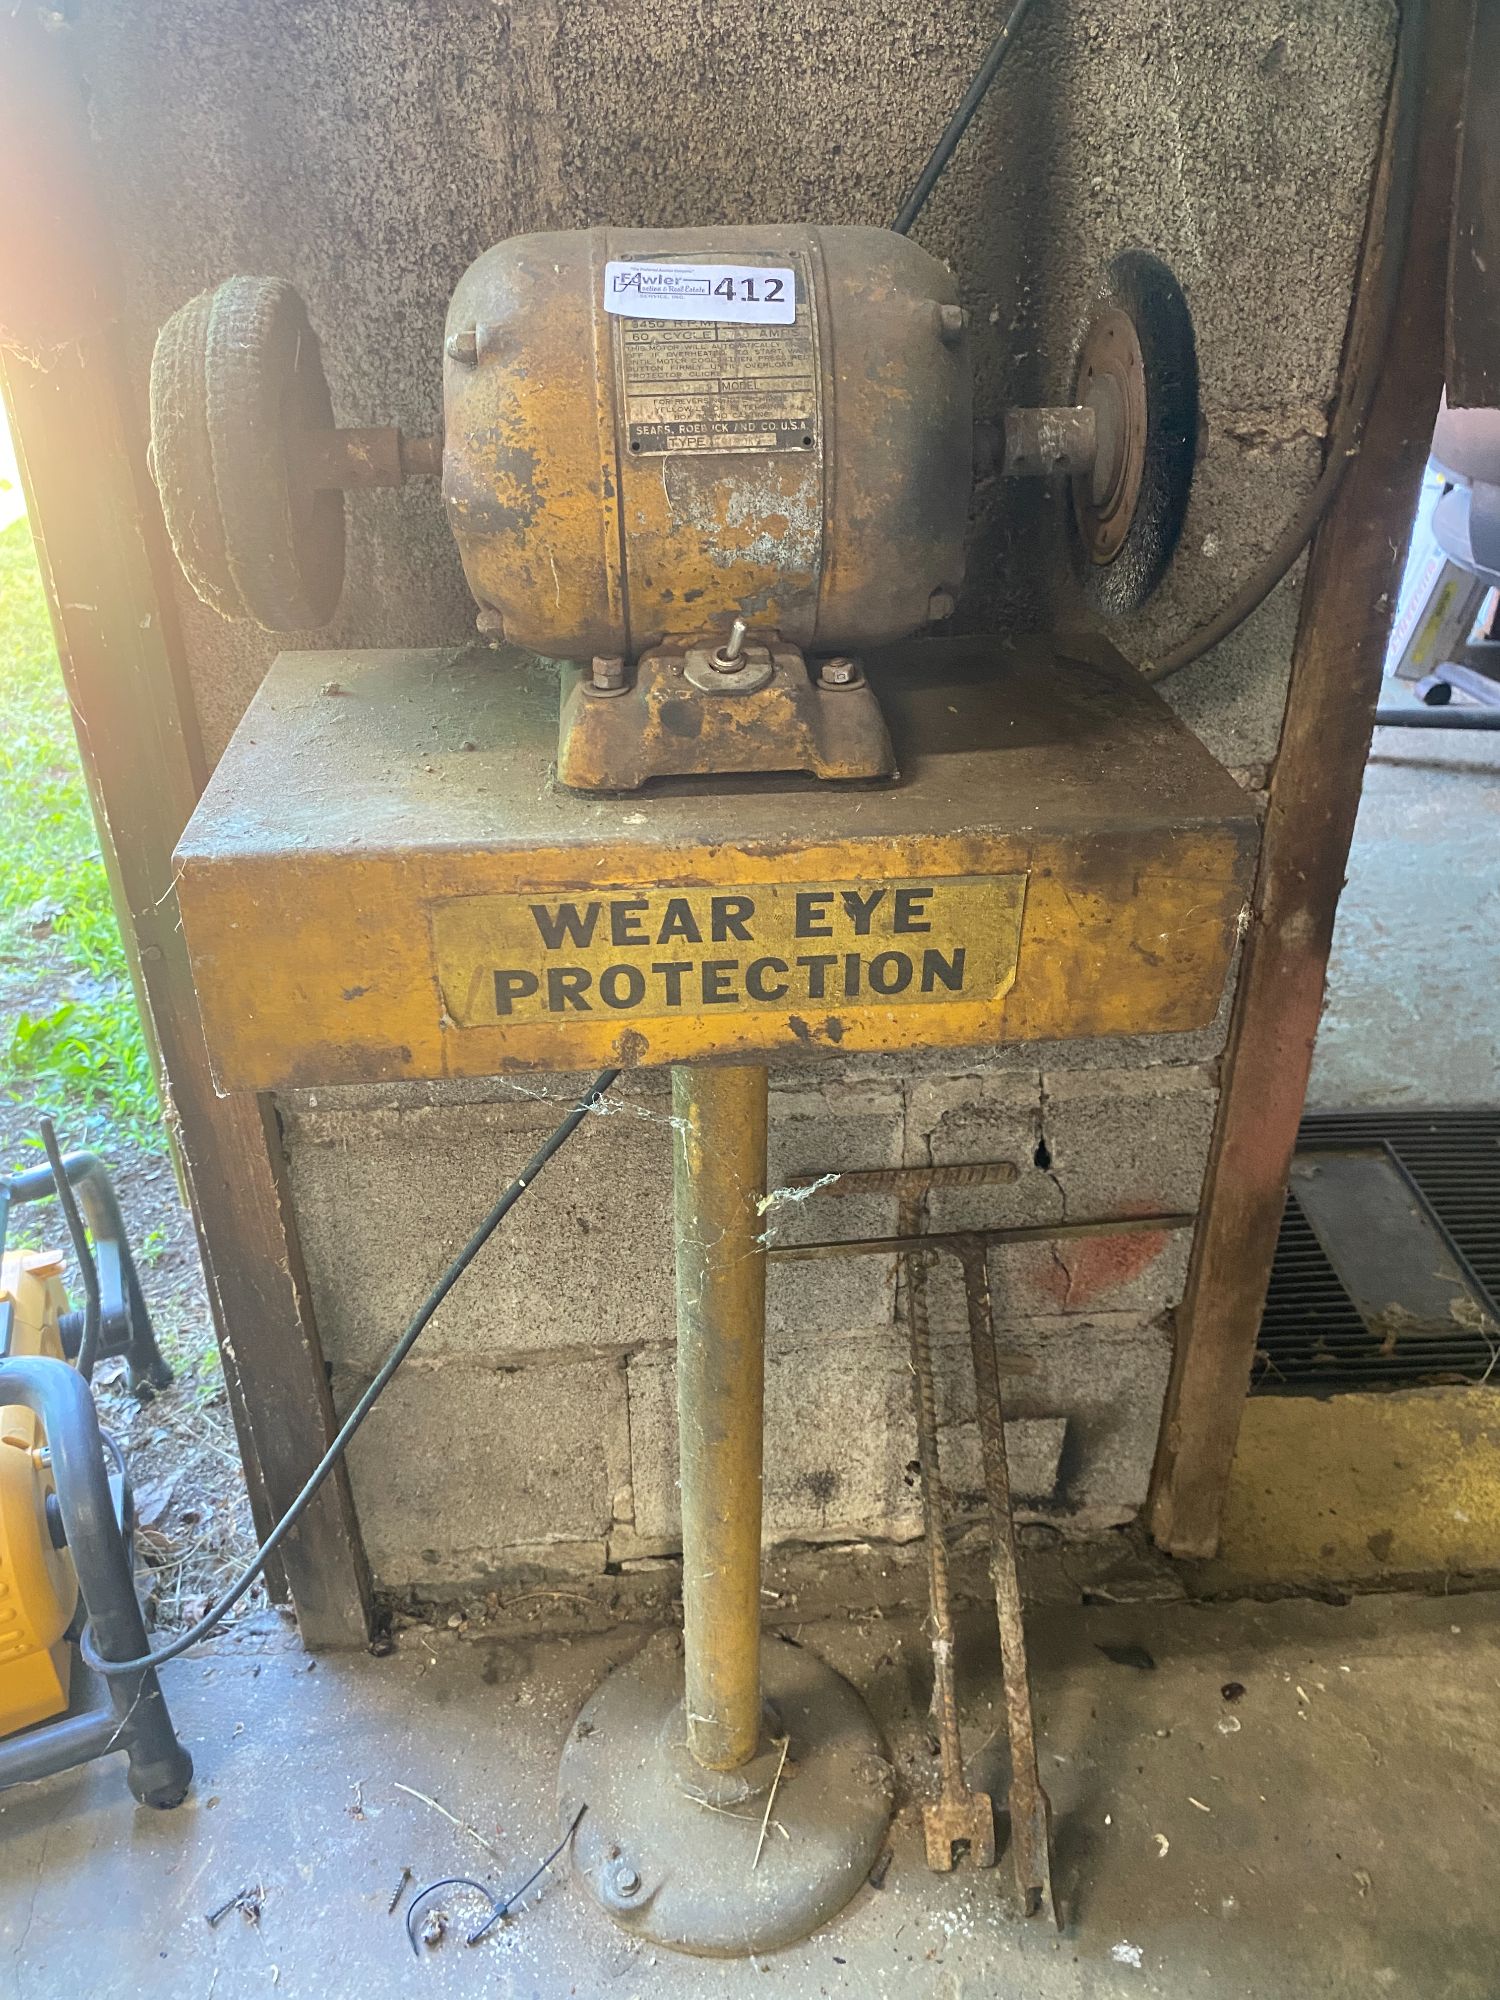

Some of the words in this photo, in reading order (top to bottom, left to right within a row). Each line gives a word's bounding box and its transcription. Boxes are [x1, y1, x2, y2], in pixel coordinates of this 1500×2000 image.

[714, 277, 785, 302] 412
[632, 333, 649, 341] 60
[663, 331, 712, 341] CYCLE
[744, 360, 794, 369] OVERLOAD
[627, 371, 683, 379] PROTECTOR
[722, 380, 760, 391] MODEL
[679, 422, 729, 435] ROEBCK
[668, 437, 706, 448] TYPE
[531, 895, 755, 950] WEAR
[795, 888, 933, 938] EYE
[494, 948, 966, 1015] PROTECTION
